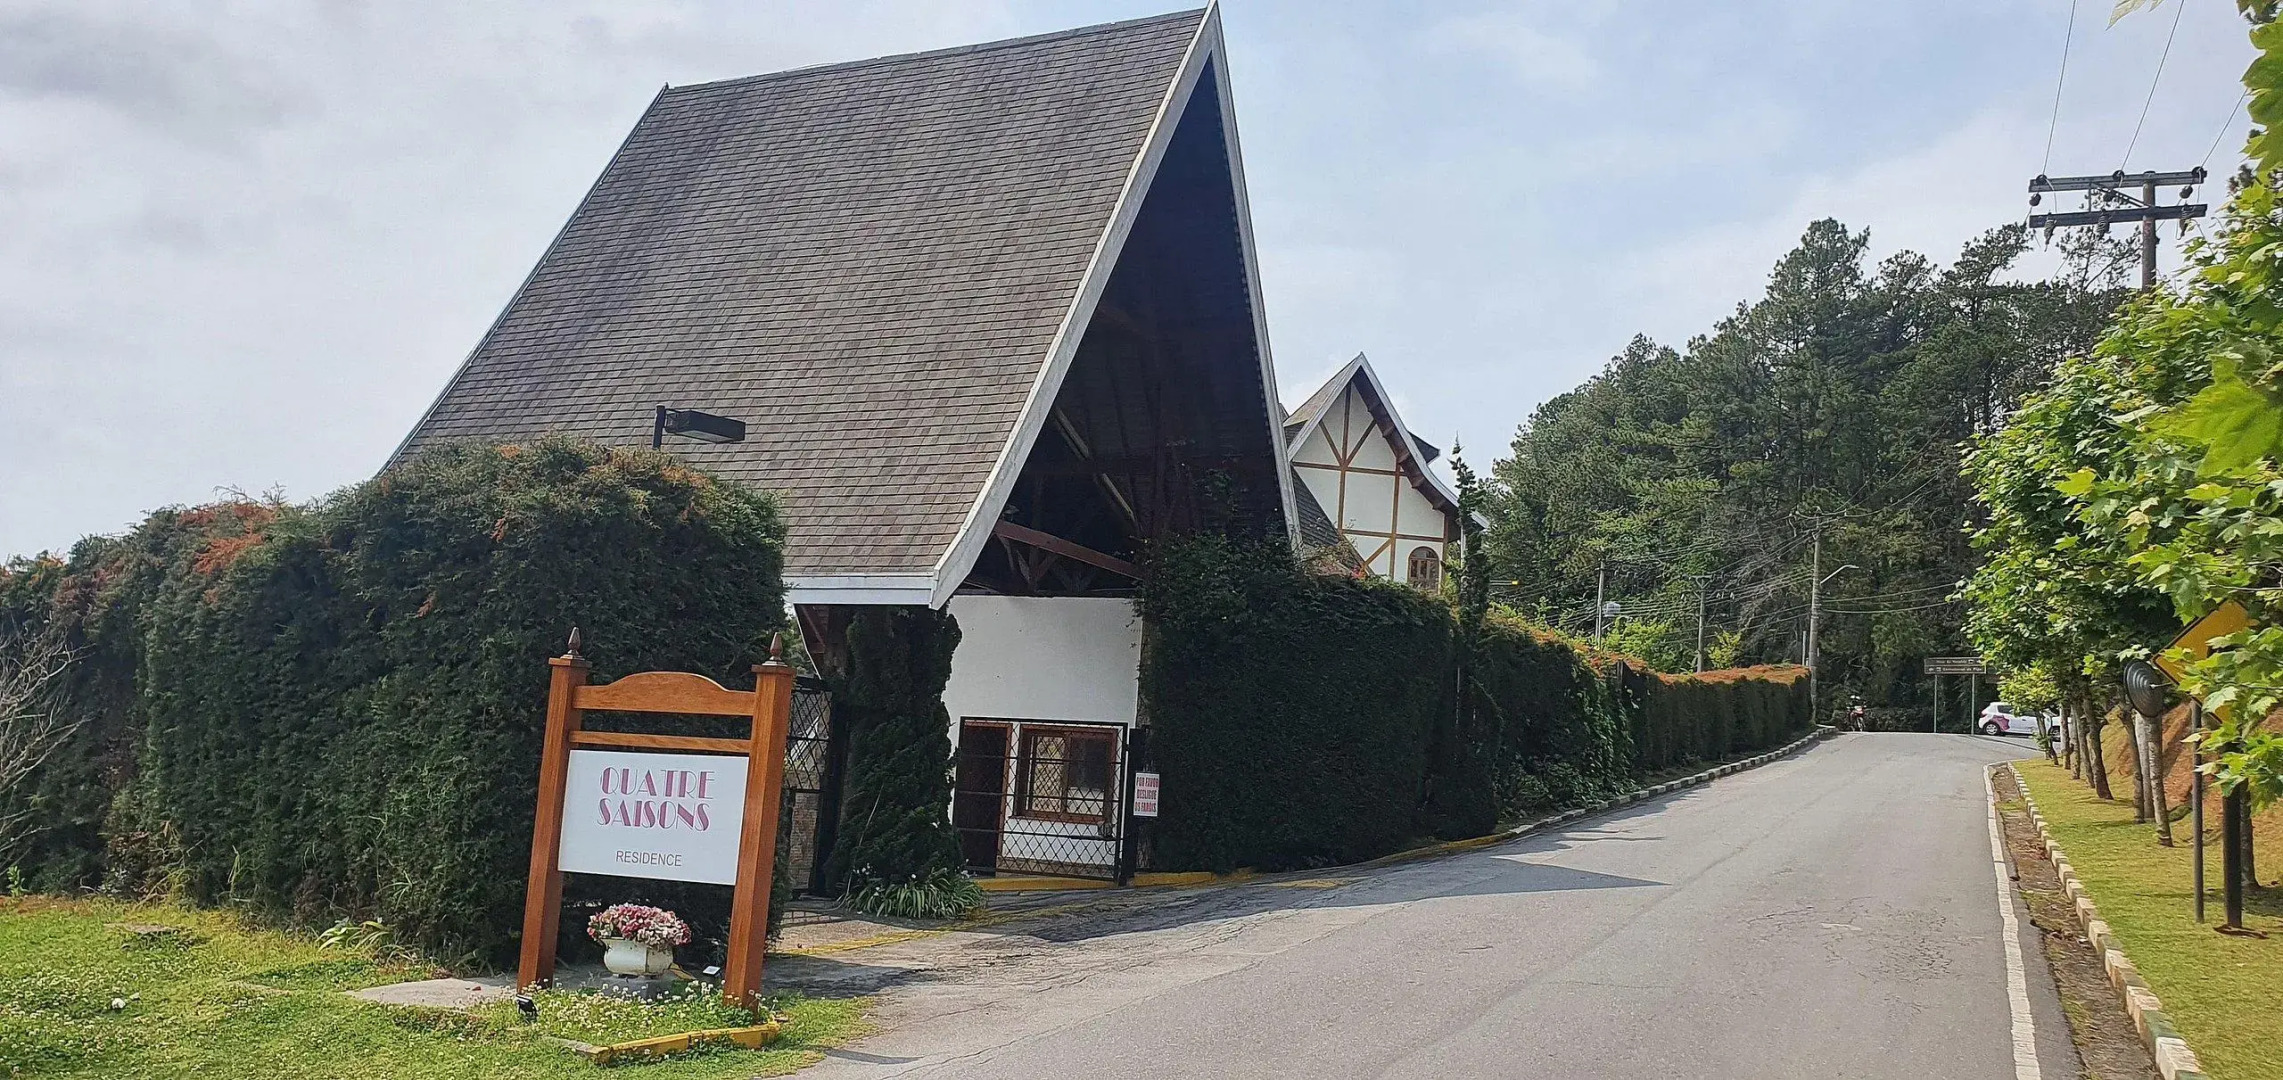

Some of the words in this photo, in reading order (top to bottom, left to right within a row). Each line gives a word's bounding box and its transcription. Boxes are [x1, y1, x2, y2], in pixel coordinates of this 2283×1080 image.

[600, 766, 715, 800] QUATRE
[597, 798, 710, 832] SAISONS
[616, 850, 682, 867] RESIDENCE
